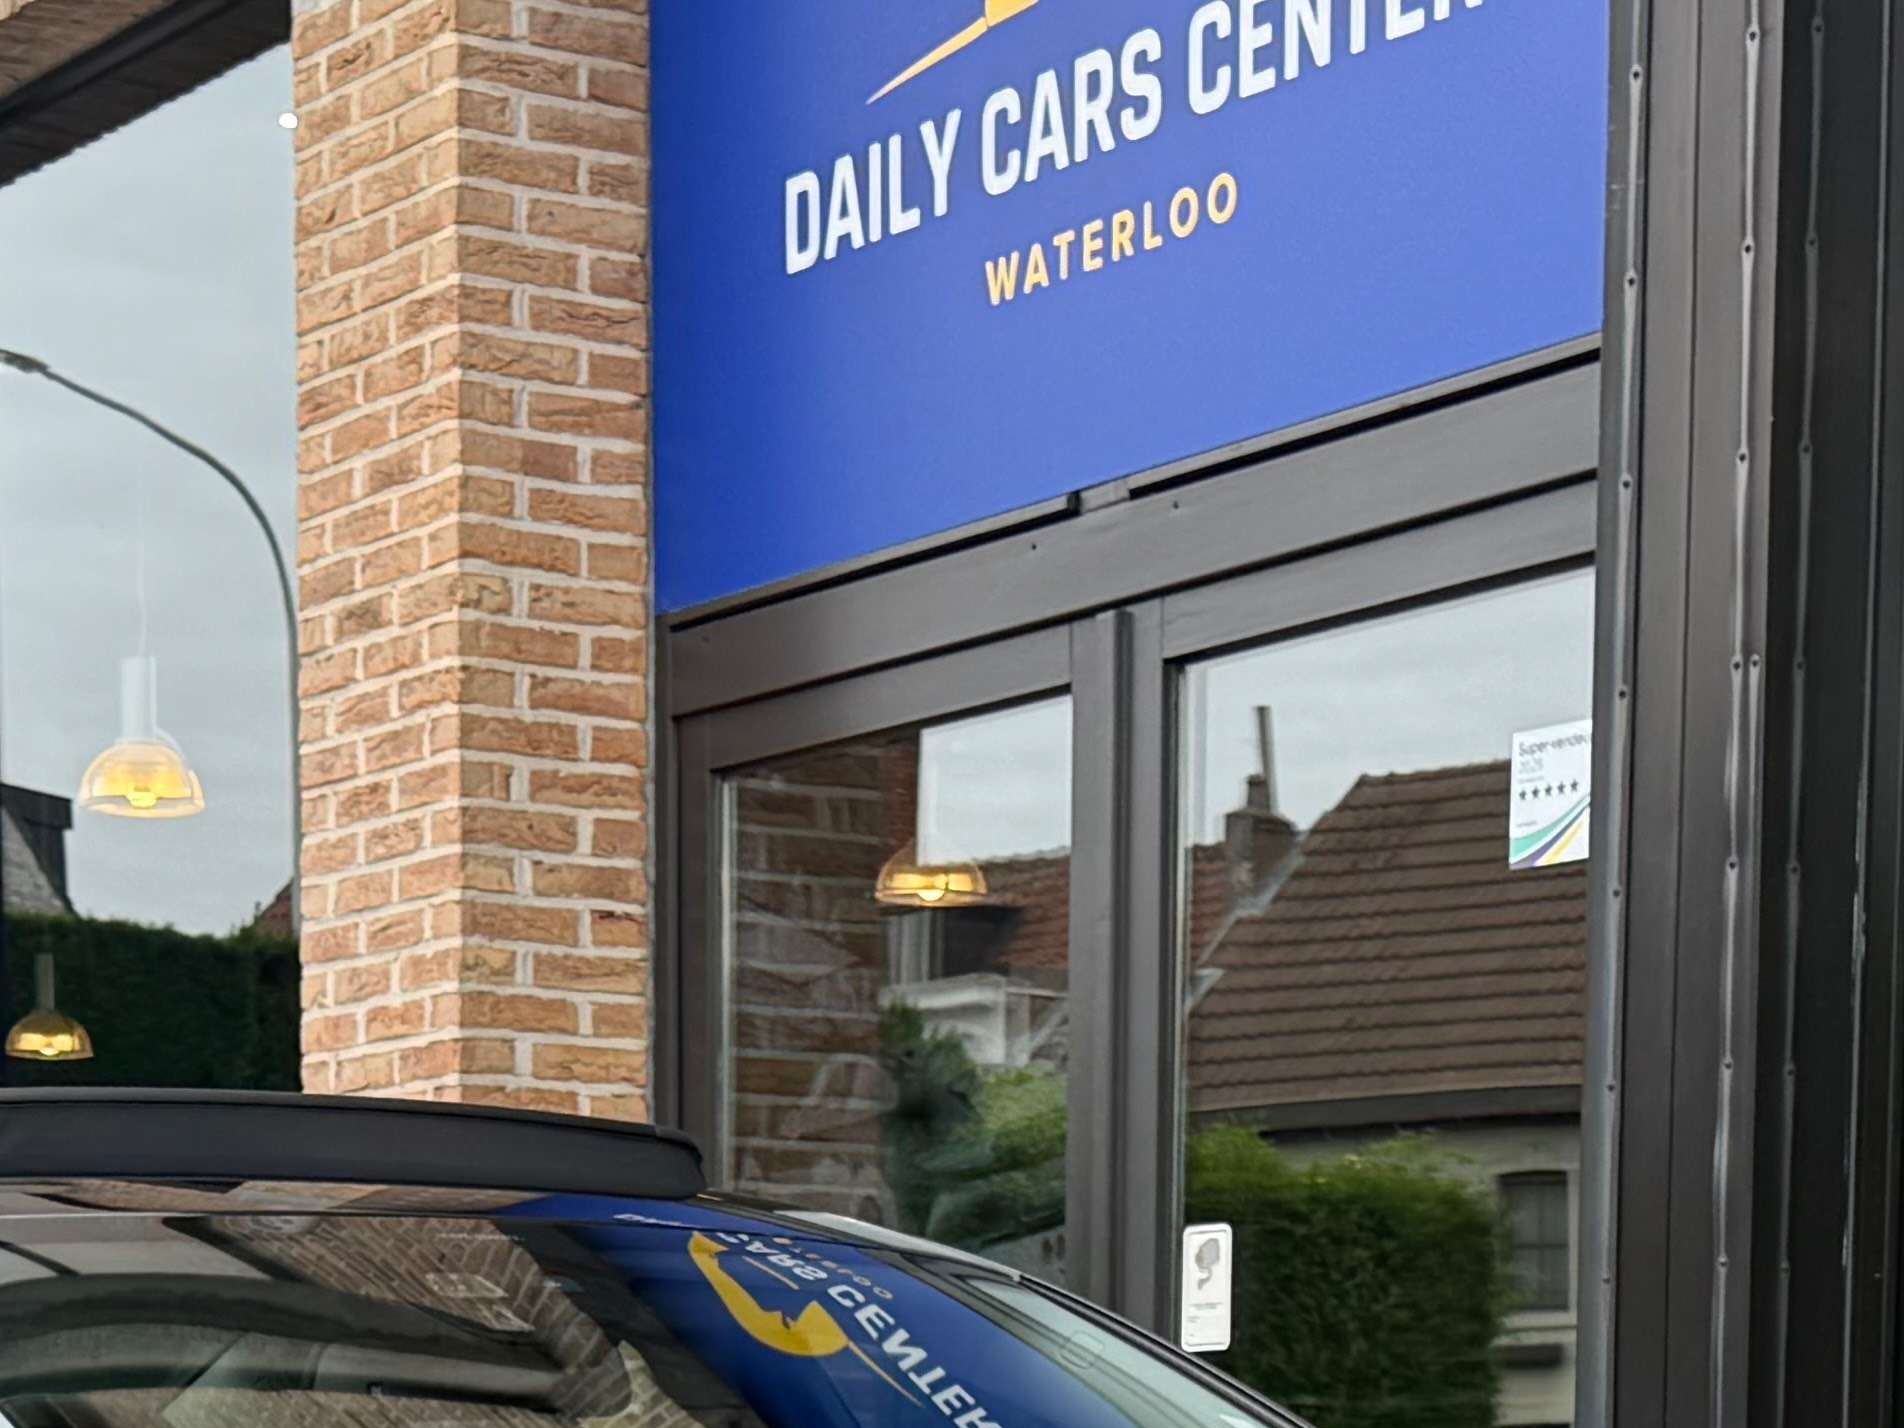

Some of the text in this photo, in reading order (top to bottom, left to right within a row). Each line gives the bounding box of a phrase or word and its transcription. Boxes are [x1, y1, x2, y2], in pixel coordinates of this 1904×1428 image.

[784, 108, 963, 276] DAILY
[980, 26, 1163, 197] CARS
[984, 172, 1238, 307] WATERLOO
